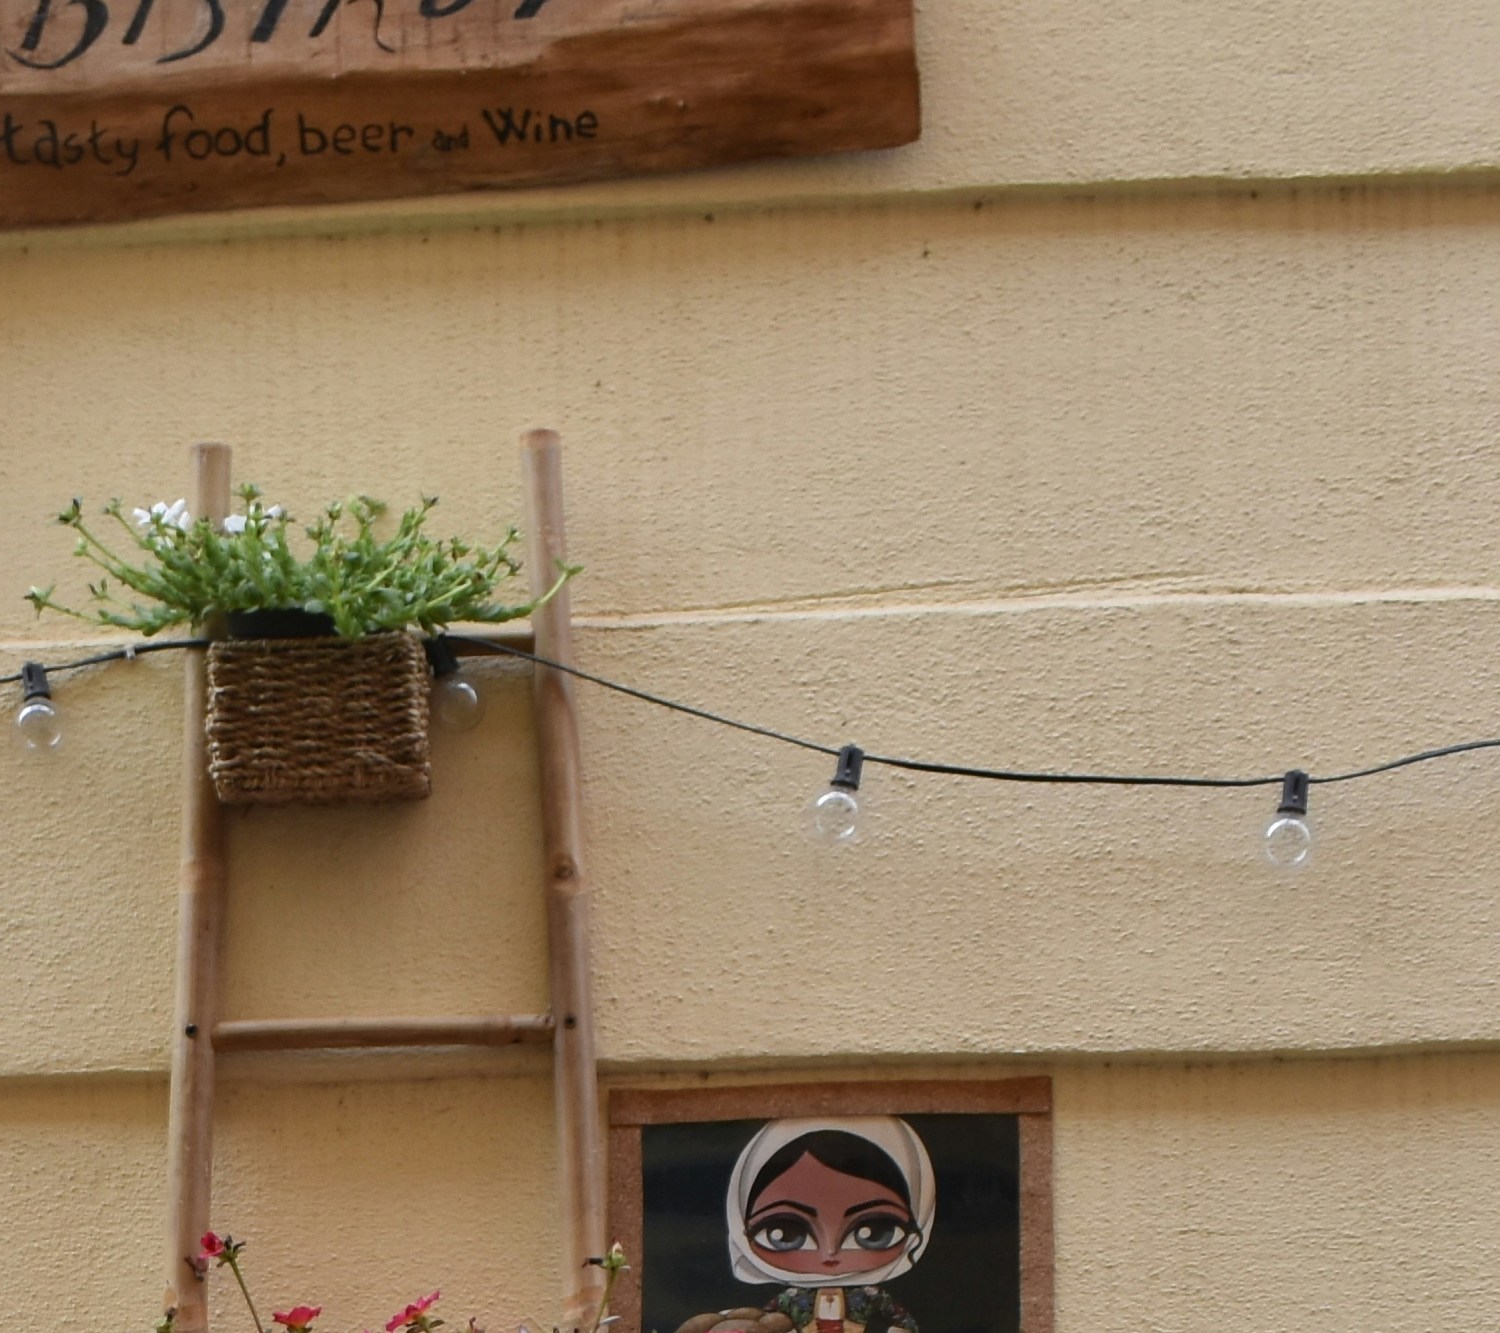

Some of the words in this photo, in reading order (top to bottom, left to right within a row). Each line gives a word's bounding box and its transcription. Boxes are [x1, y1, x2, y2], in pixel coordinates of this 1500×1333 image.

[155, 104, 287, 167] food,
[297, 112, 414, 155] beer
[432, 124, 470, 152] and
[480, 105, 600, 145] Wine
